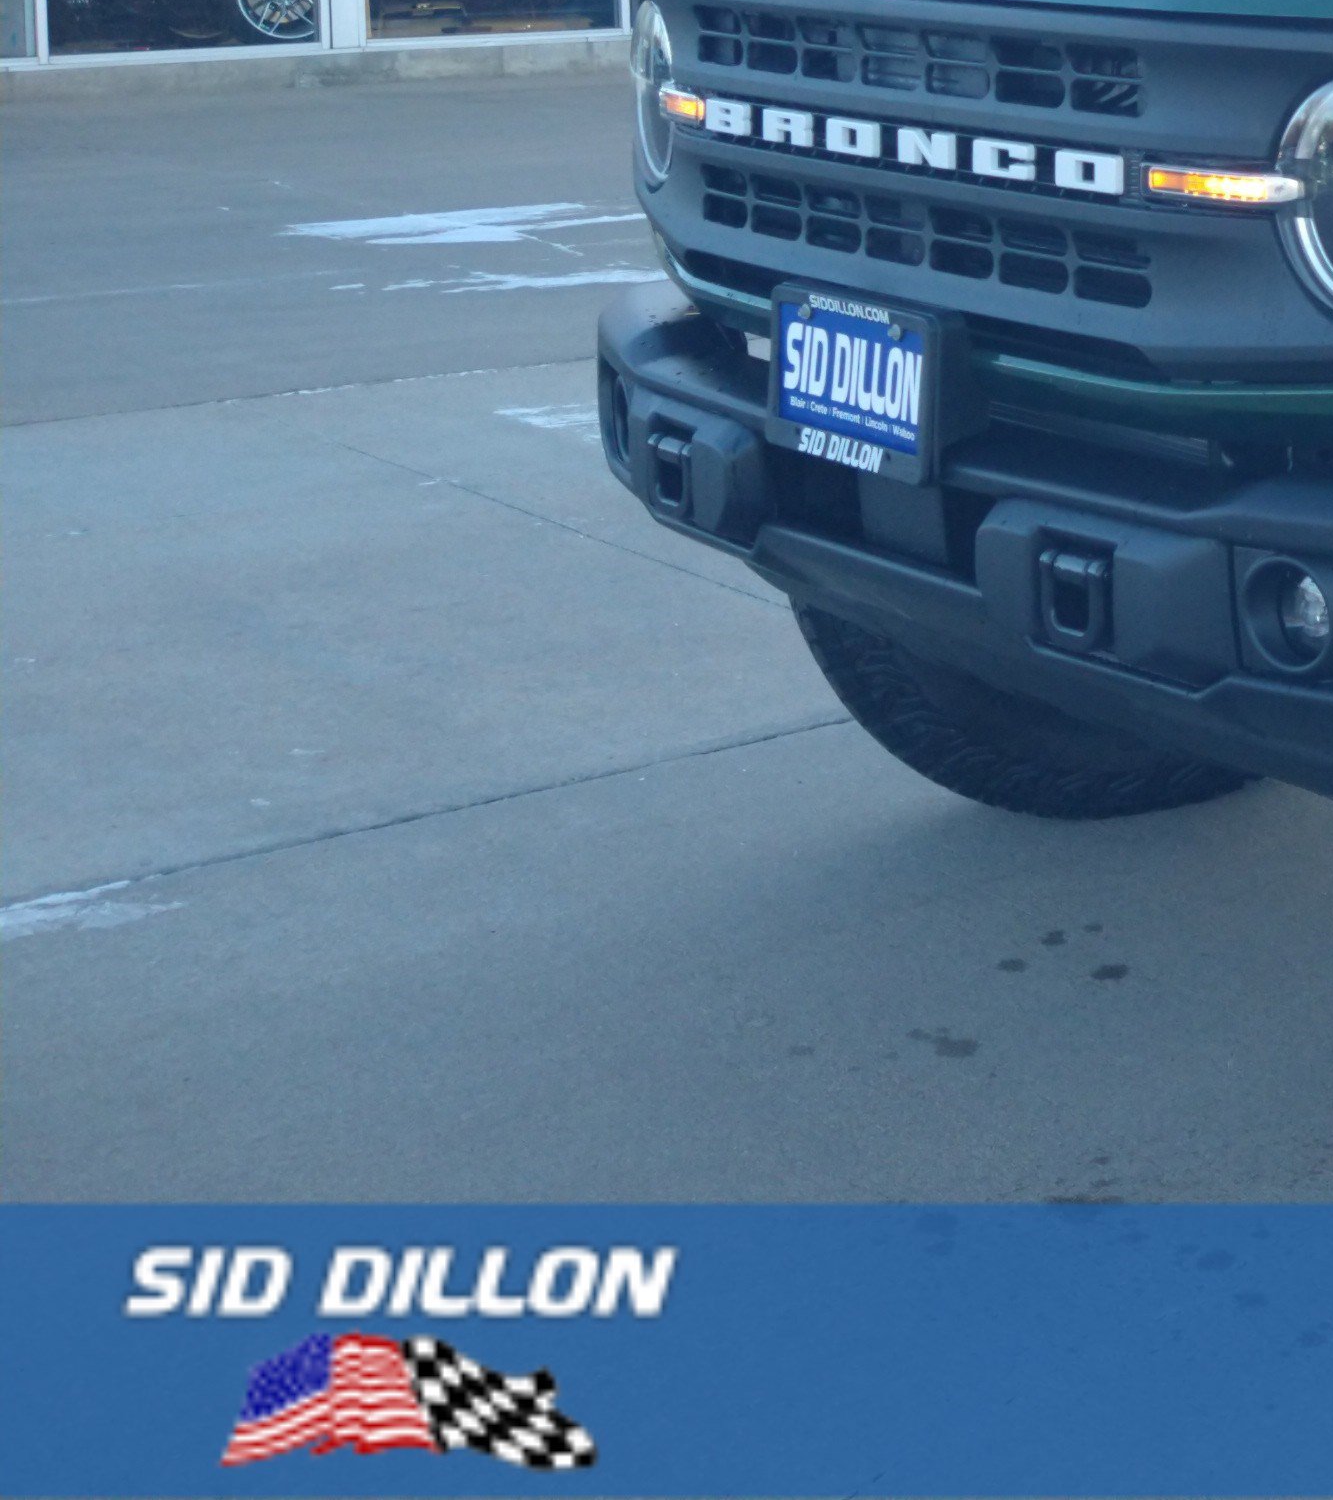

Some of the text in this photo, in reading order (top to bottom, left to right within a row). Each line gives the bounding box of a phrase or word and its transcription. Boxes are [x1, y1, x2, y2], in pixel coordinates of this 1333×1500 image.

[704, 98, 1125, 195] BRONCO
[809, 295, 889, 324] SIDDILLON.COM
[784, 322, 922, 424] SID DILLON
[811, 402, 827, 414] Crete
[833, 408, 860, 423] Fremont
[866, 417, 887, 432] Lincoln
[799, 428, 883, 473] SID DILLON
